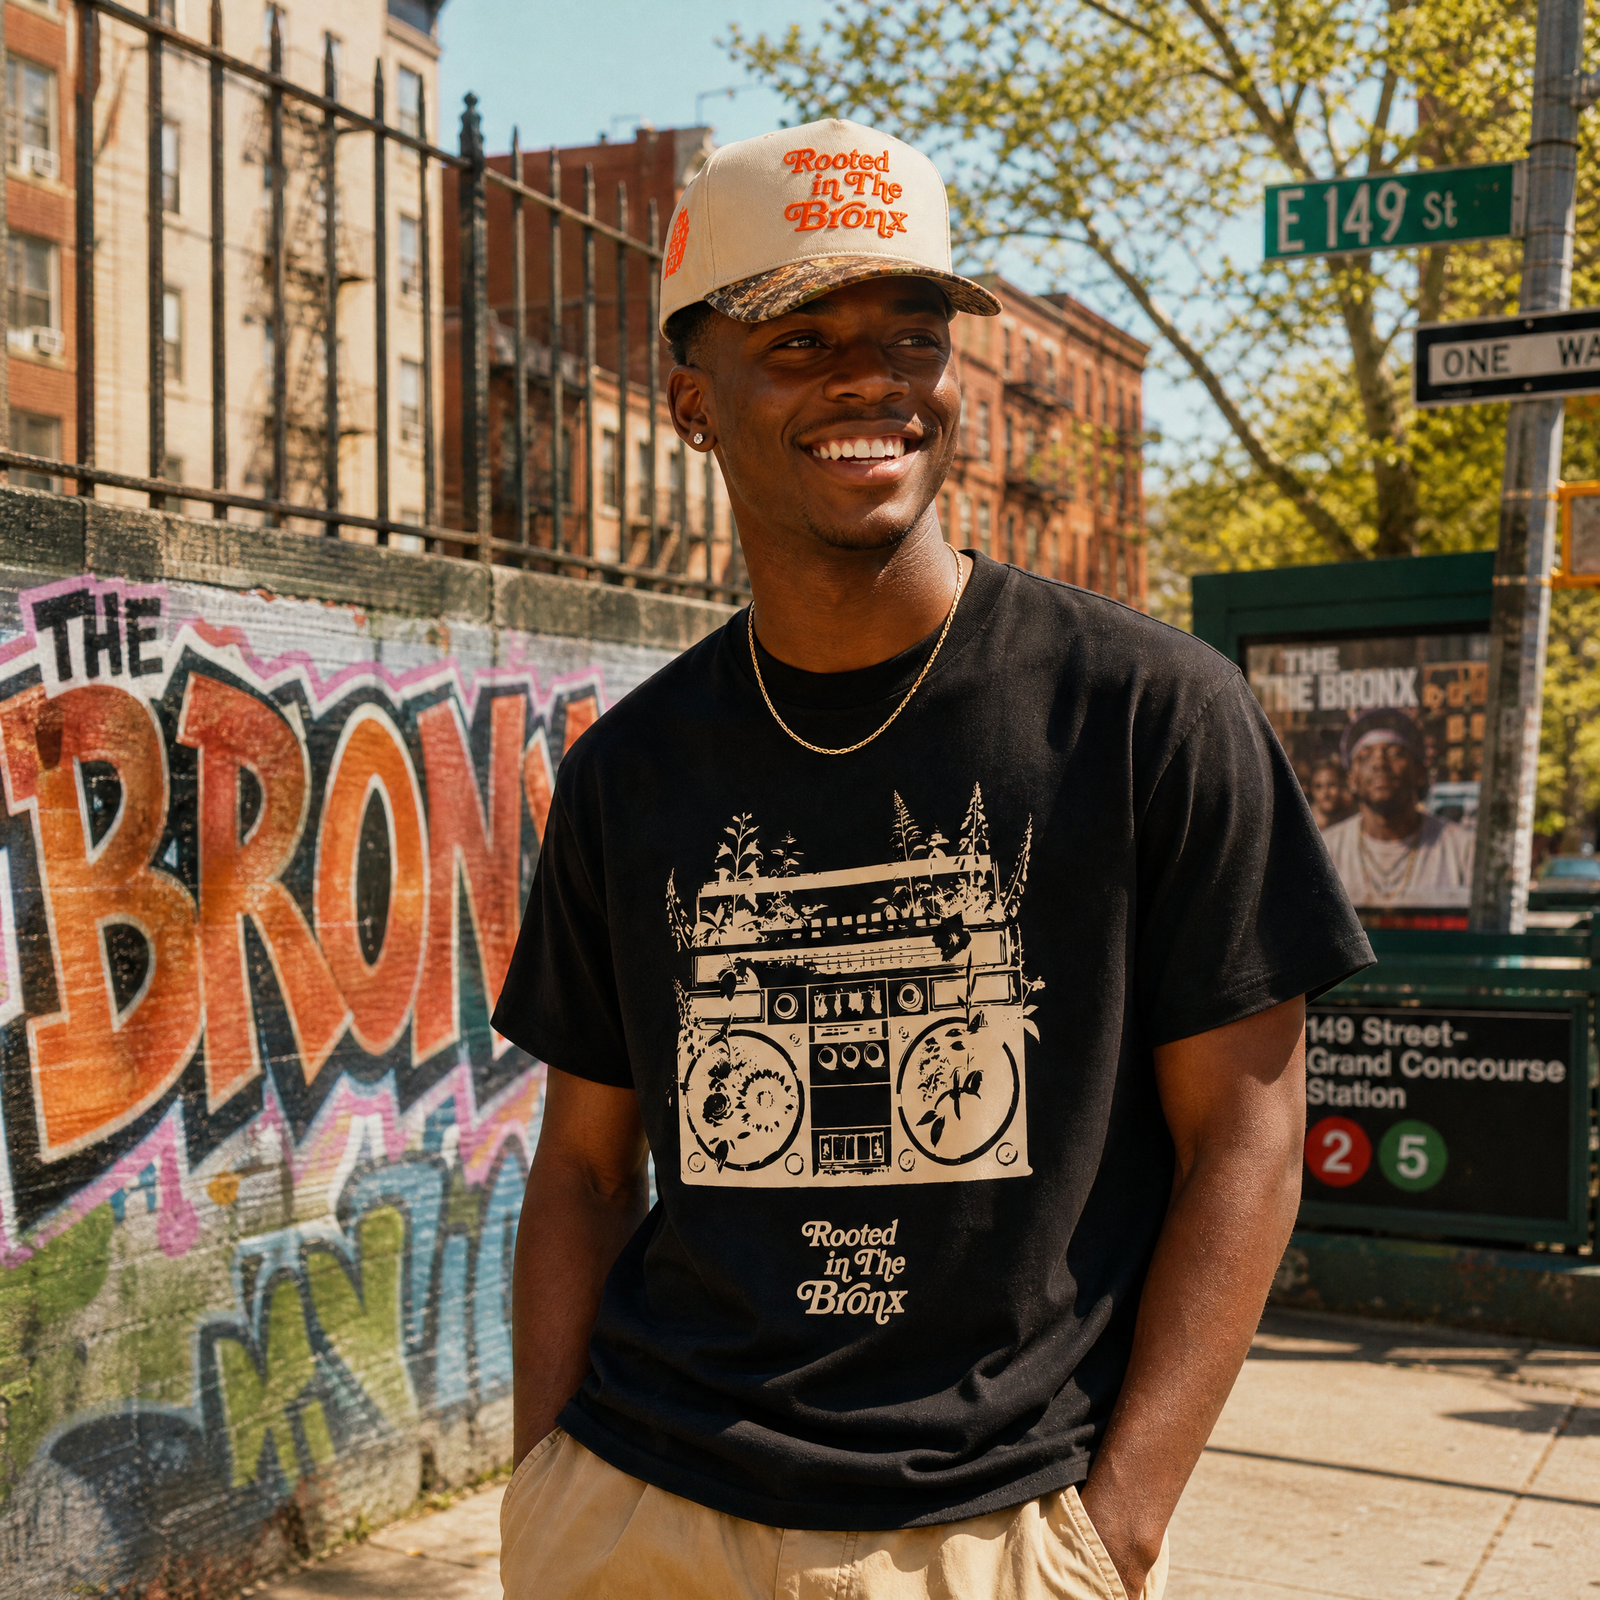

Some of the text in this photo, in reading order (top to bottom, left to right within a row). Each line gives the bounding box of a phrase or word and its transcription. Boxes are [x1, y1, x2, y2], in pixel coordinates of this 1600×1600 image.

[783, 148, 890, 173] Rooted
[811, 170, 903, 204] in The
[784, 199, 908, 239] Bronx
[1277, 180, 1458, 253] E 149 St
[1443, 343, 1512, 378] ONE
[32, 588, 164, 682] THE
[1281, 646, 1341, 673] THE
[1318, 666, 1420, 711] BRONX
[0, 670, 600, 1162] BRON
[1306, 1015, 1468, 1048] 149 Street-
[1307, 1046, 1566, 1084] Grand Concourse
[1307, 1077, 1407, 1109] Station
[1321, 1128, 1429, 1179] 2 5
[801, 1219, 899, 1247] Rooted
[823, 1248, 906, 1283] in The
[796, 1280, 908, 1325] Bronx
